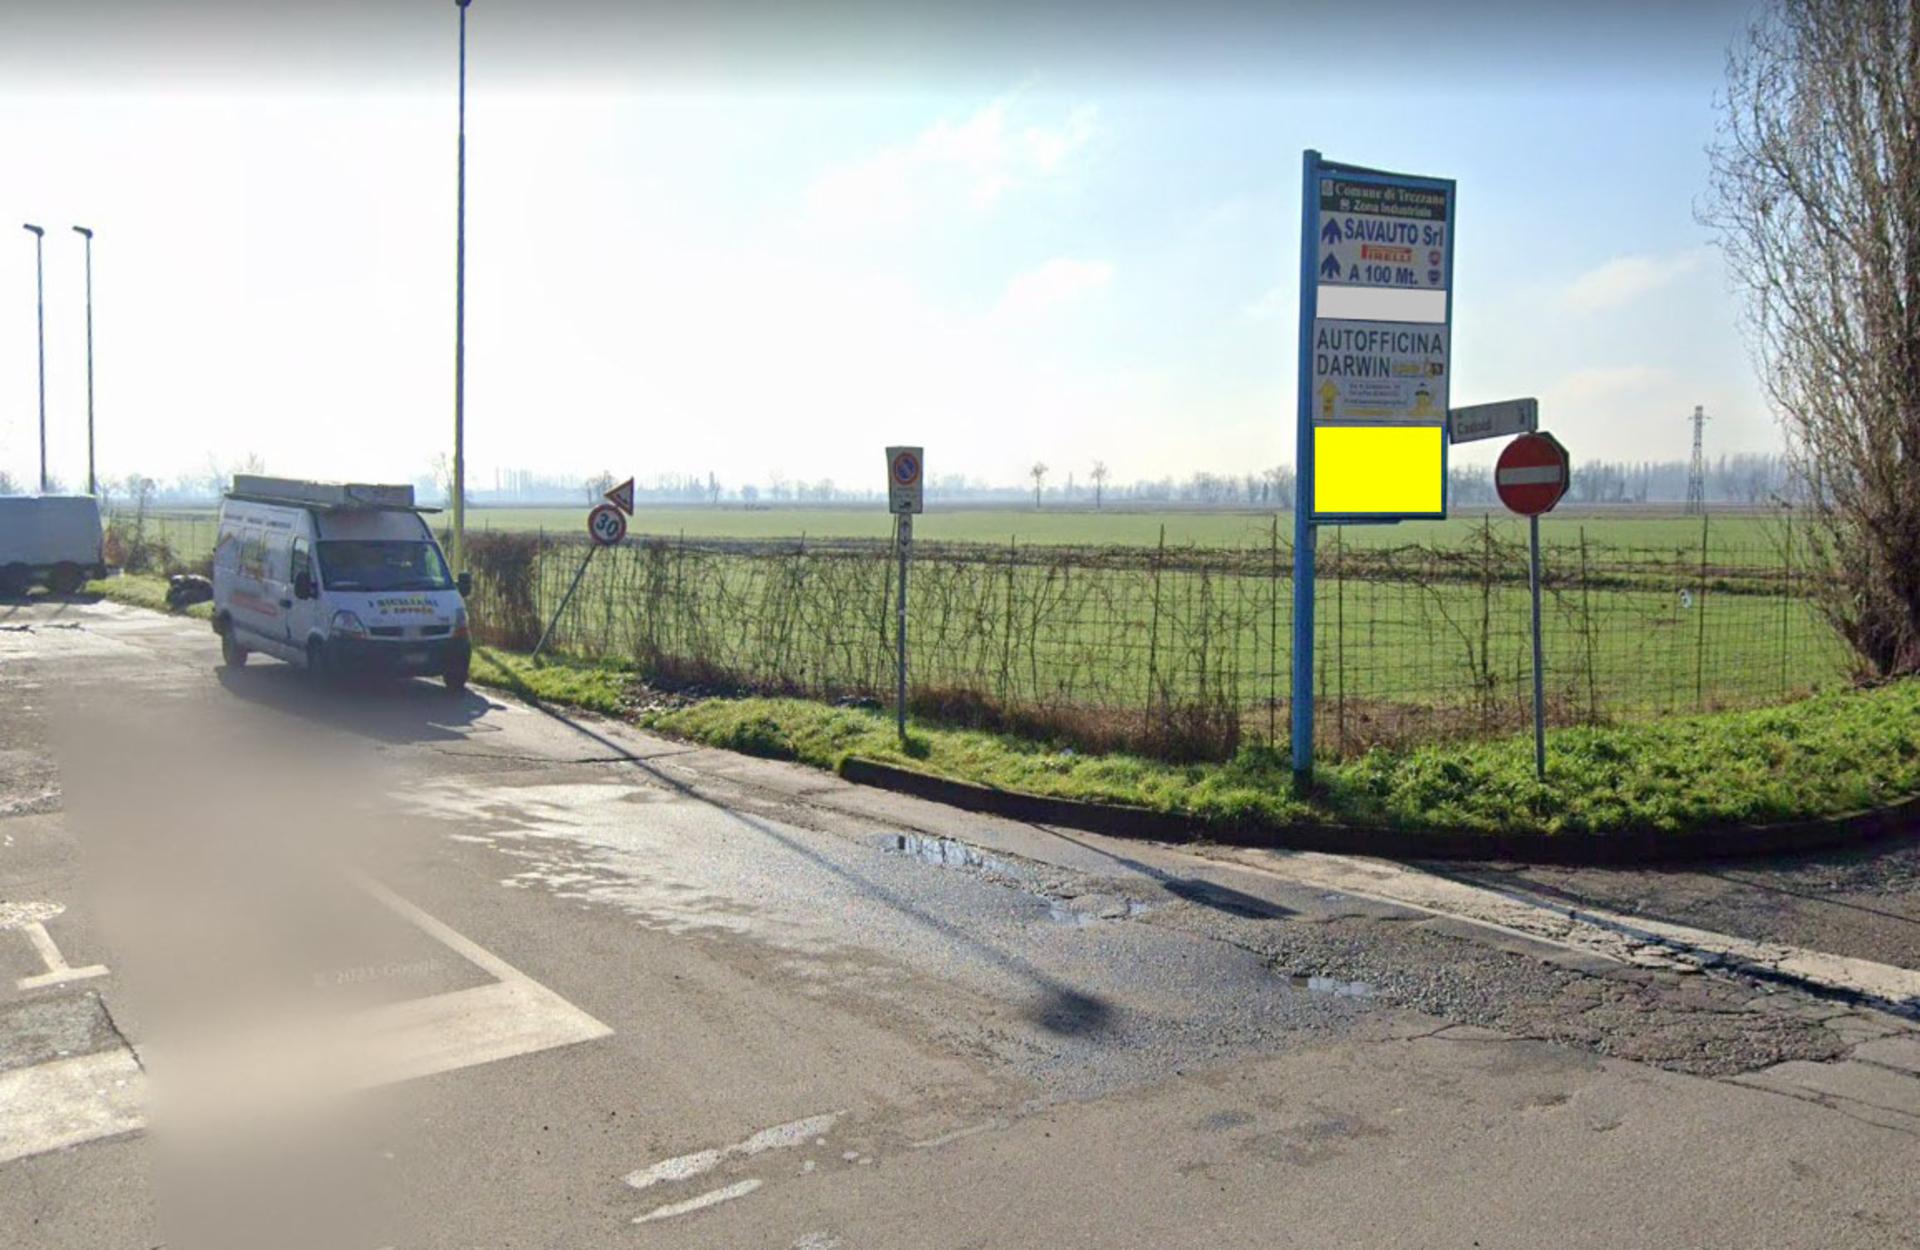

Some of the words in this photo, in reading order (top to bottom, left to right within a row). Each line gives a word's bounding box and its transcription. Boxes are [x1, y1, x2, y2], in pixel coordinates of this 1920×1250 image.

[1335, 183, 1382, 199] Comune
[1384, 187, 1395, 200] di
[1353, 200, 1379, 213] Zona
[1345, 218, 1419, 244] SAVAUTO
[1423, 226, 1444, 247] Srl
[1361, 244, 1412, 264] PIRELLI
[1350, 265, 1360, 281] A
[1366, 266, 1392, 284] 100
[1395, 268, 1418, 285] Mt.
[1317, 328, 1443, 354] AUTOFFICINA
[1317, 354, 1391, 378] DARWIN
[595, 512, 619, 538] 30
